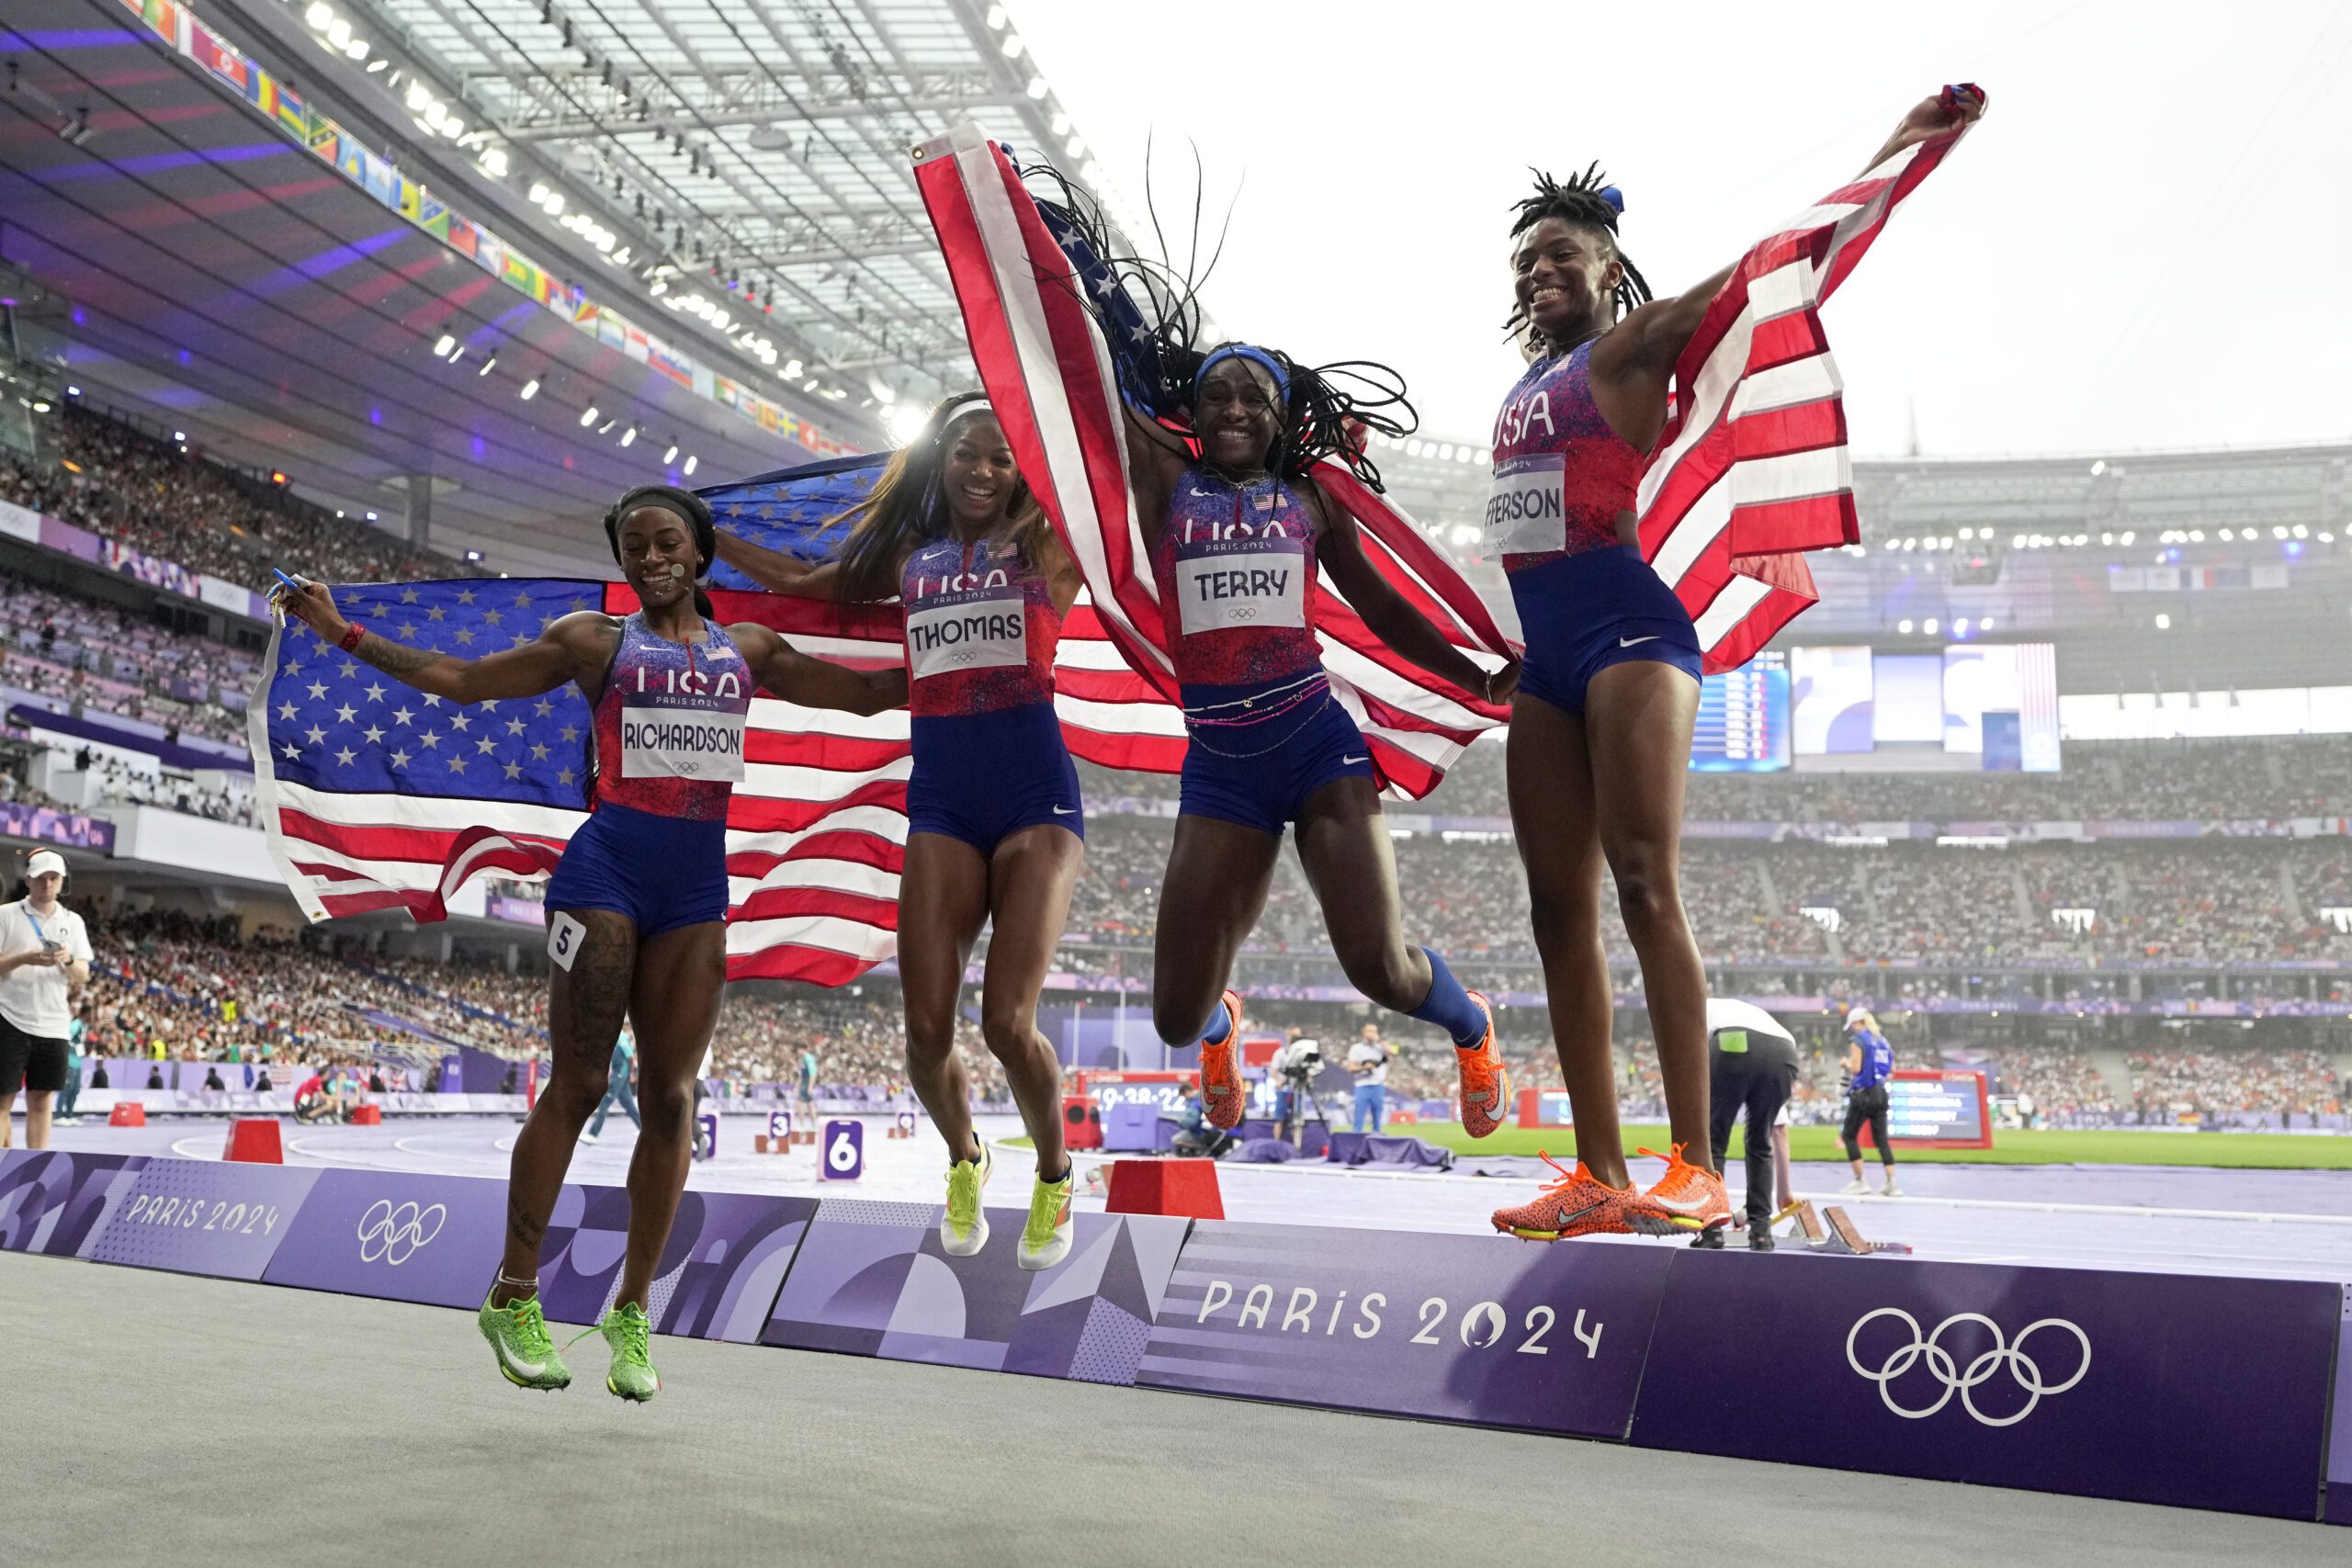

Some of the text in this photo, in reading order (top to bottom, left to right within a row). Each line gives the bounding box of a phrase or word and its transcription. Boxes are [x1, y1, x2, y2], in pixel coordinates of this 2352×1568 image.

[1485, 488, 1561, 527] FFERSON
[1194, 570, 1288, 602] TERRY
[910, 614, 1023, 652] THOMAS
[624, 723, 741, 755] RICHARDSON
[556, 925, 572, 955] 5
[772, 1115, 789, 1137] 3
[829, 1132, 858, 1172] 6
[203, 1201, 279, 1235] 2024
[1409, 1296, 1604, 1359] 2024
